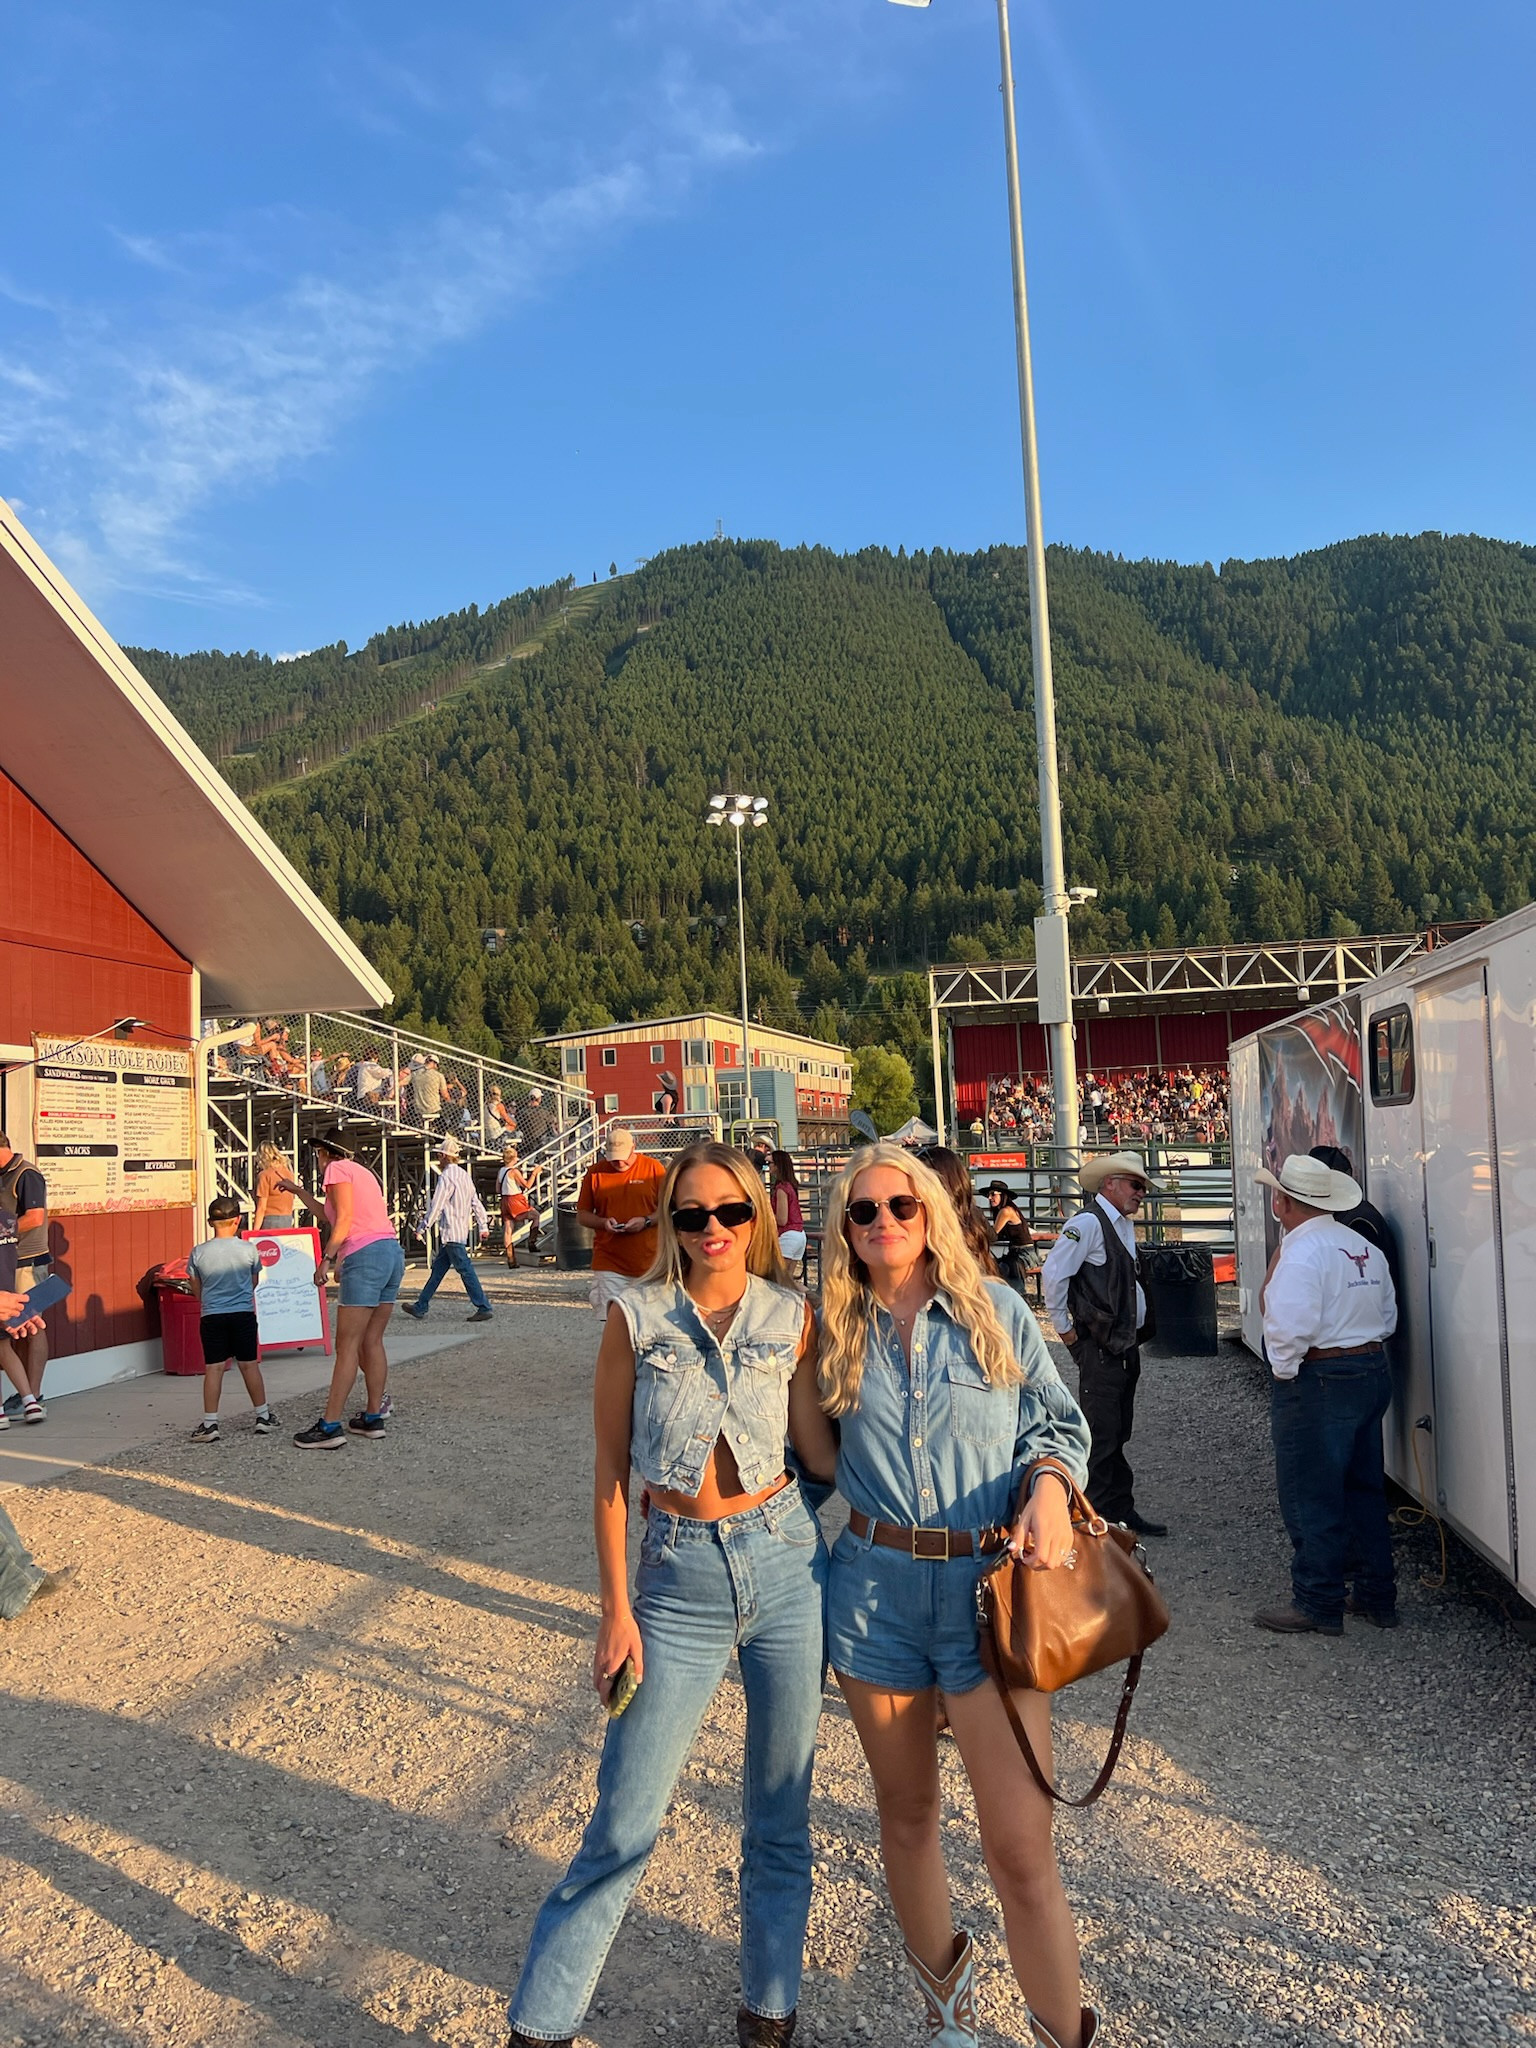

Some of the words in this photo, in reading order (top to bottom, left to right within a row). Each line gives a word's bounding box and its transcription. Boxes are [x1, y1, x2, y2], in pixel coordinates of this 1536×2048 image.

[40, 1042, 106, 1067] JACKSON
[108, 1049, 144, 1070] HOLE
[146, 1053, 188, 1073] RODEO
[44, 1068, 81, 1079] SANDWICHES
[143, 1076, 160, 1085] MORE
[64, 1146, 91, 1155] SNACKS
[144, 1161, 176, 1170] BEVERAGES
